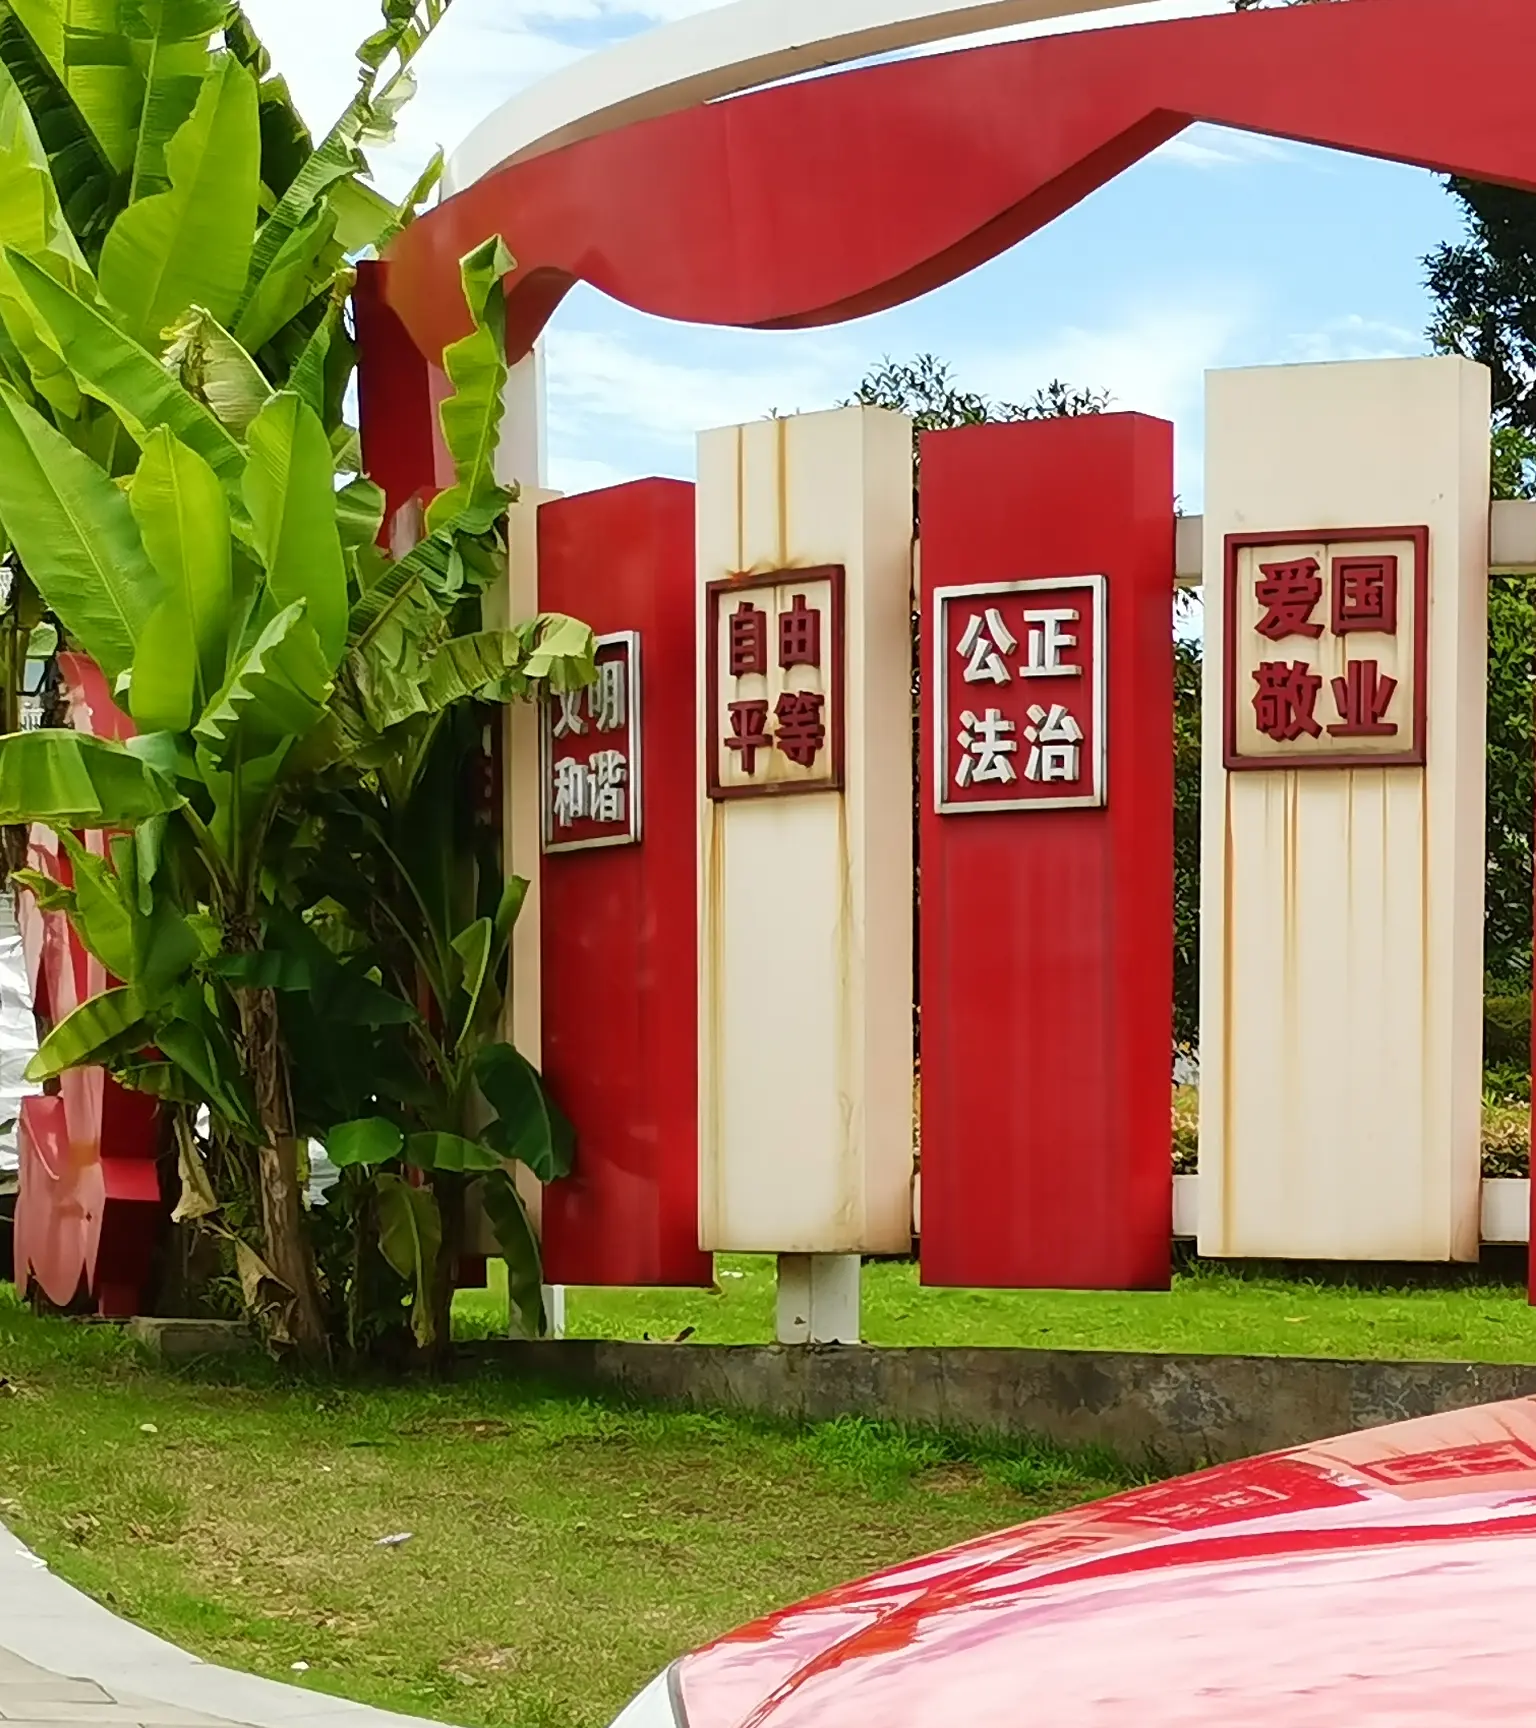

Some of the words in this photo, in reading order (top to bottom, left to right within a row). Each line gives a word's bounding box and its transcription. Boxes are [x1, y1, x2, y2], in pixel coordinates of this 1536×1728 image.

[728, 594, 823, 677] 自由
[1254, 557, 1397, 641] 爱国
[955, 607, 1082, 686] 公正
[724, 691, 826, 775] 平等
[1252, 659, 1398, 741] 敬业
[955, 704, 1083, 786] 法治
[553, 750, 627, 827] 和谐
